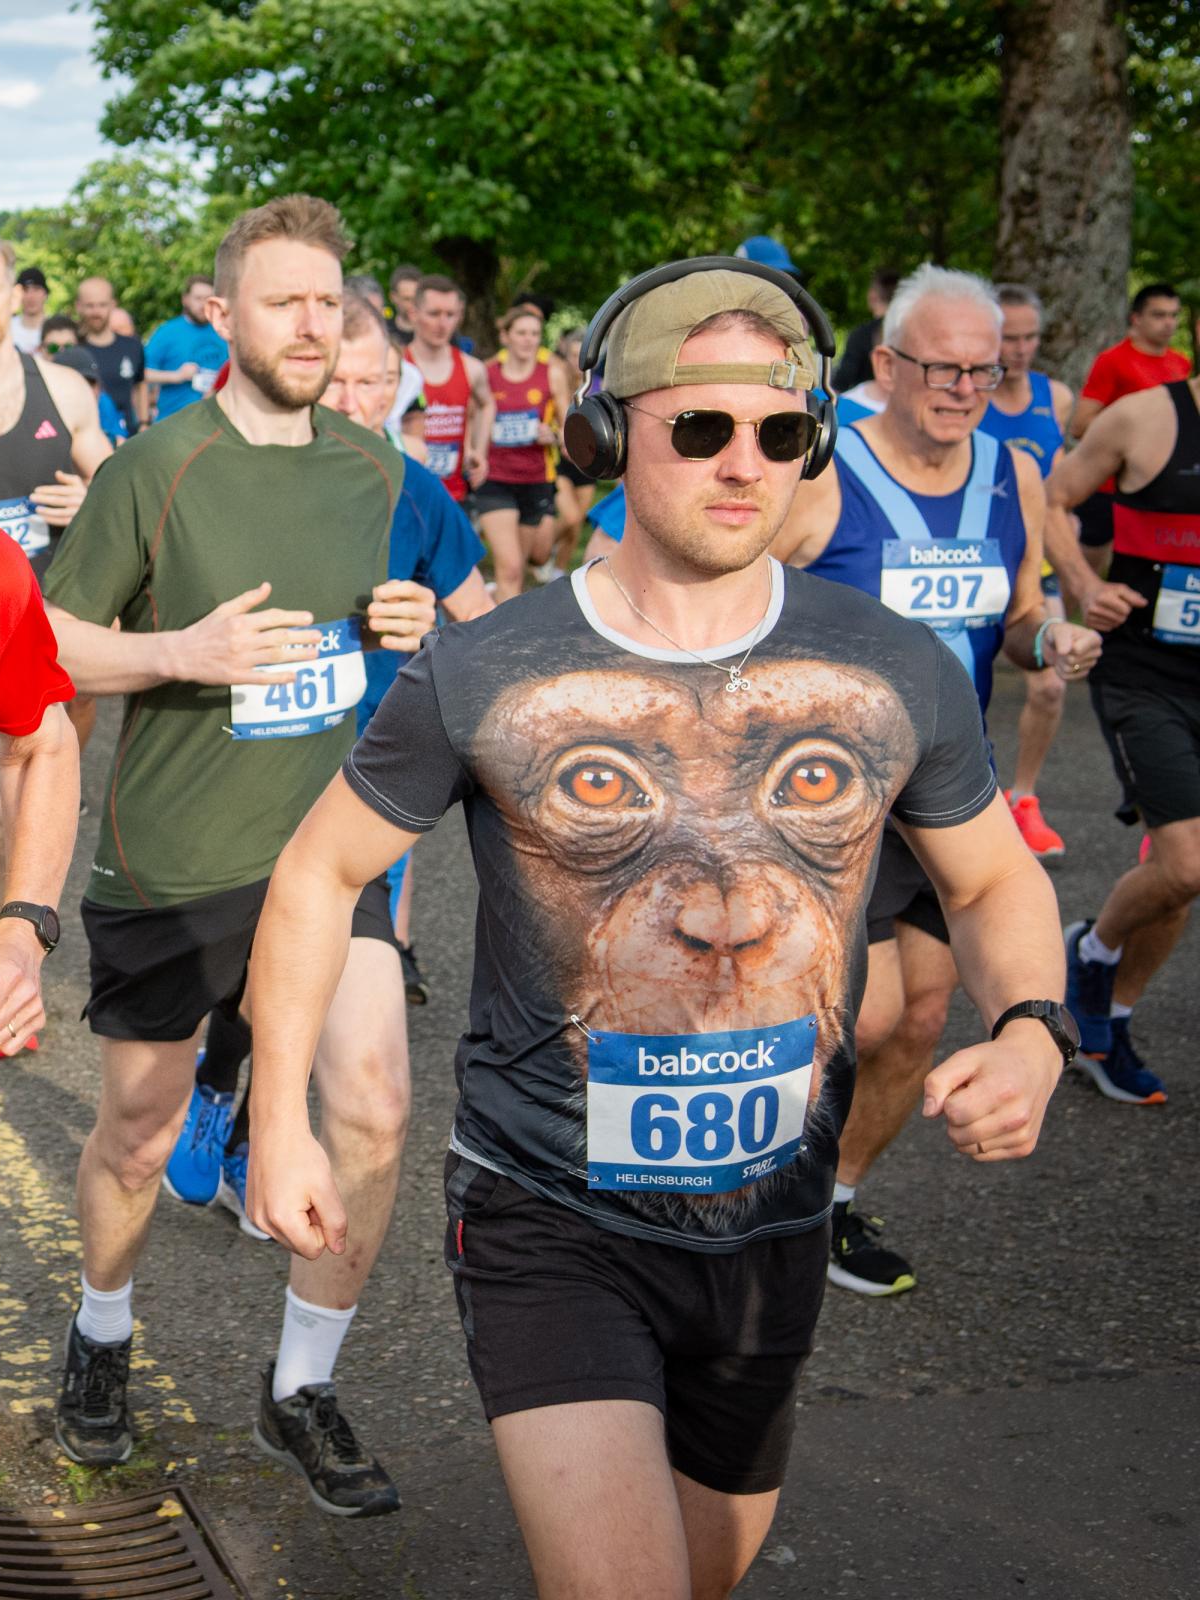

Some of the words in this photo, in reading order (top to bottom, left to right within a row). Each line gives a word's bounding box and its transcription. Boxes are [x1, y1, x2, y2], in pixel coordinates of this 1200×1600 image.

[910, 545, 983, 565] babcock
[910, 574, 984, 609] 297
[264, 663, 336, 712] 461
[638, 1040, 775, 1076] babcock
[630, 1085, 780, 1161] 680
[616, 1173, 712, 1187] HELENSBURGH
[742, 1156, 776, 1179] START
